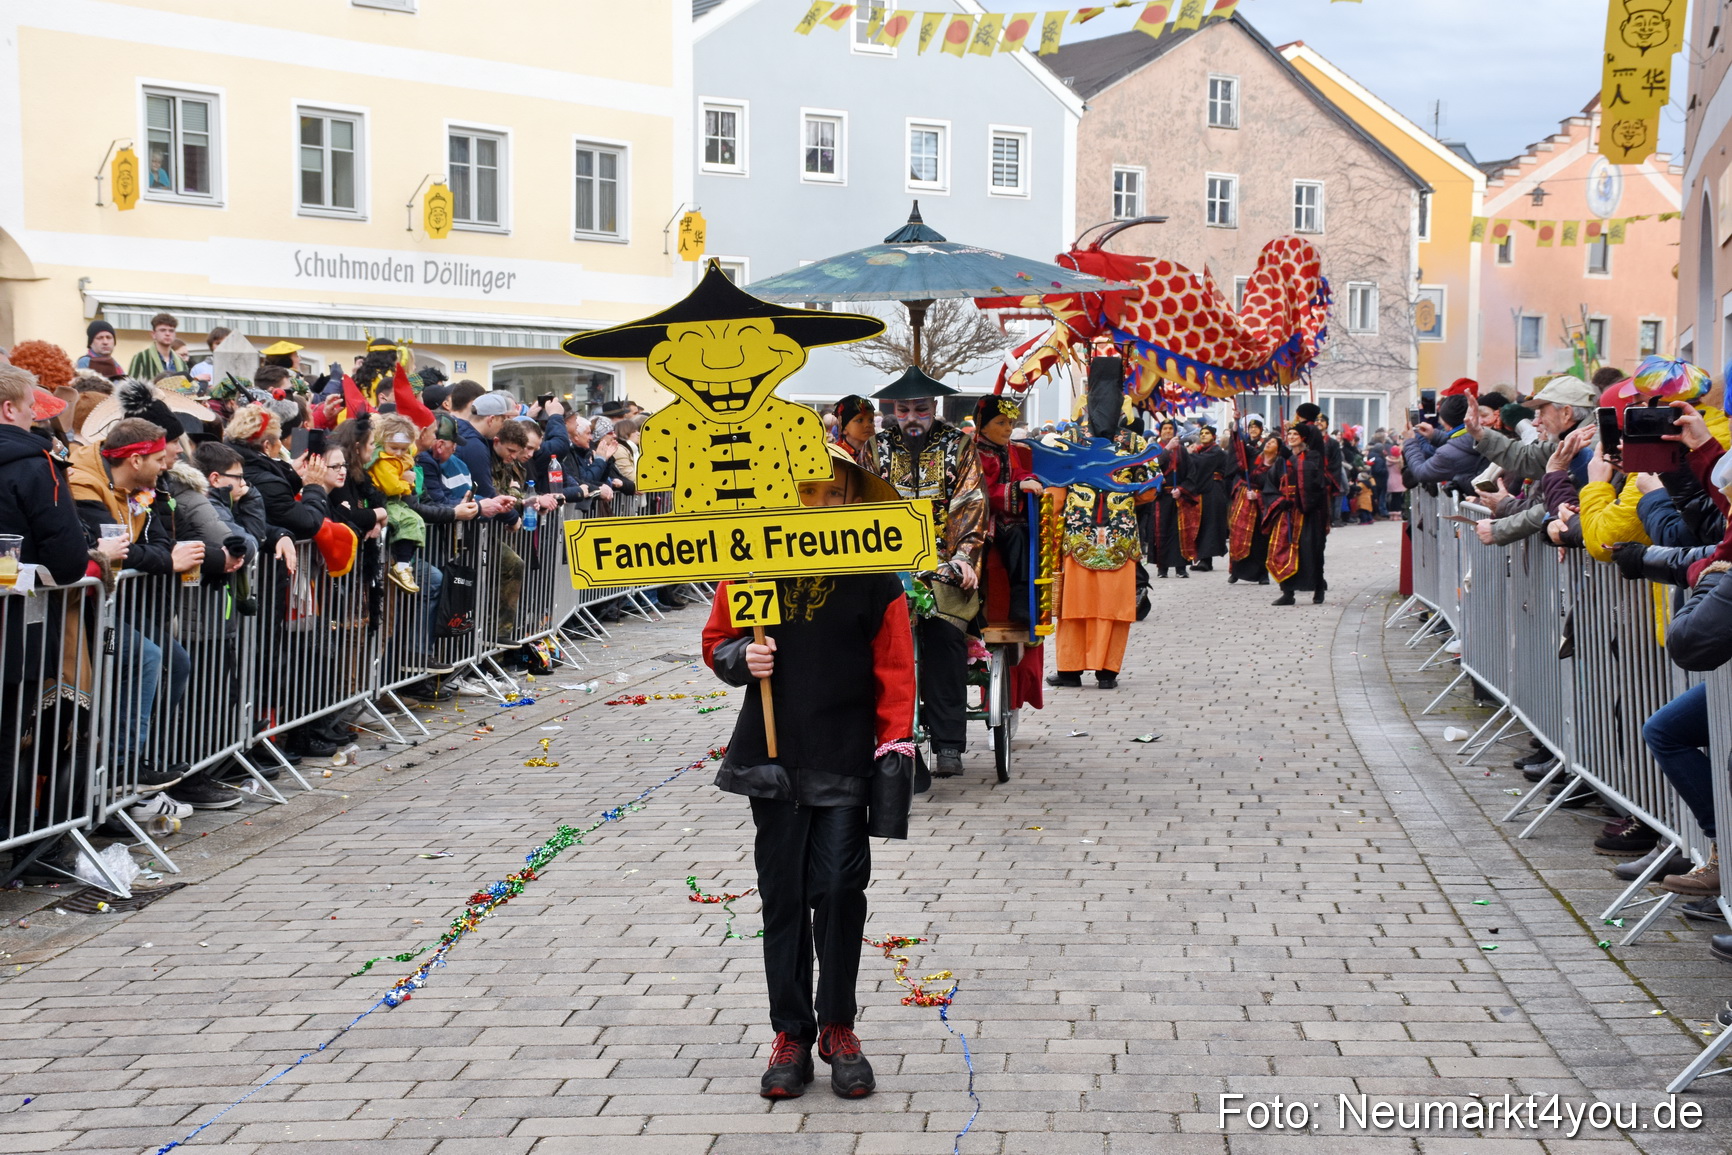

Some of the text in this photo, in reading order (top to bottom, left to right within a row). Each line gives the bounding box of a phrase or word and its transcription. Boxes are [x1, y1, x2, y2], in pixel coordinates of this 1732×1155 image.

[294, 249, 517, 294] Schuhmoden Döllinger
[592, 519, 904, 571] Fanderl & Freunde
[733, 589, 775, 621] 27
